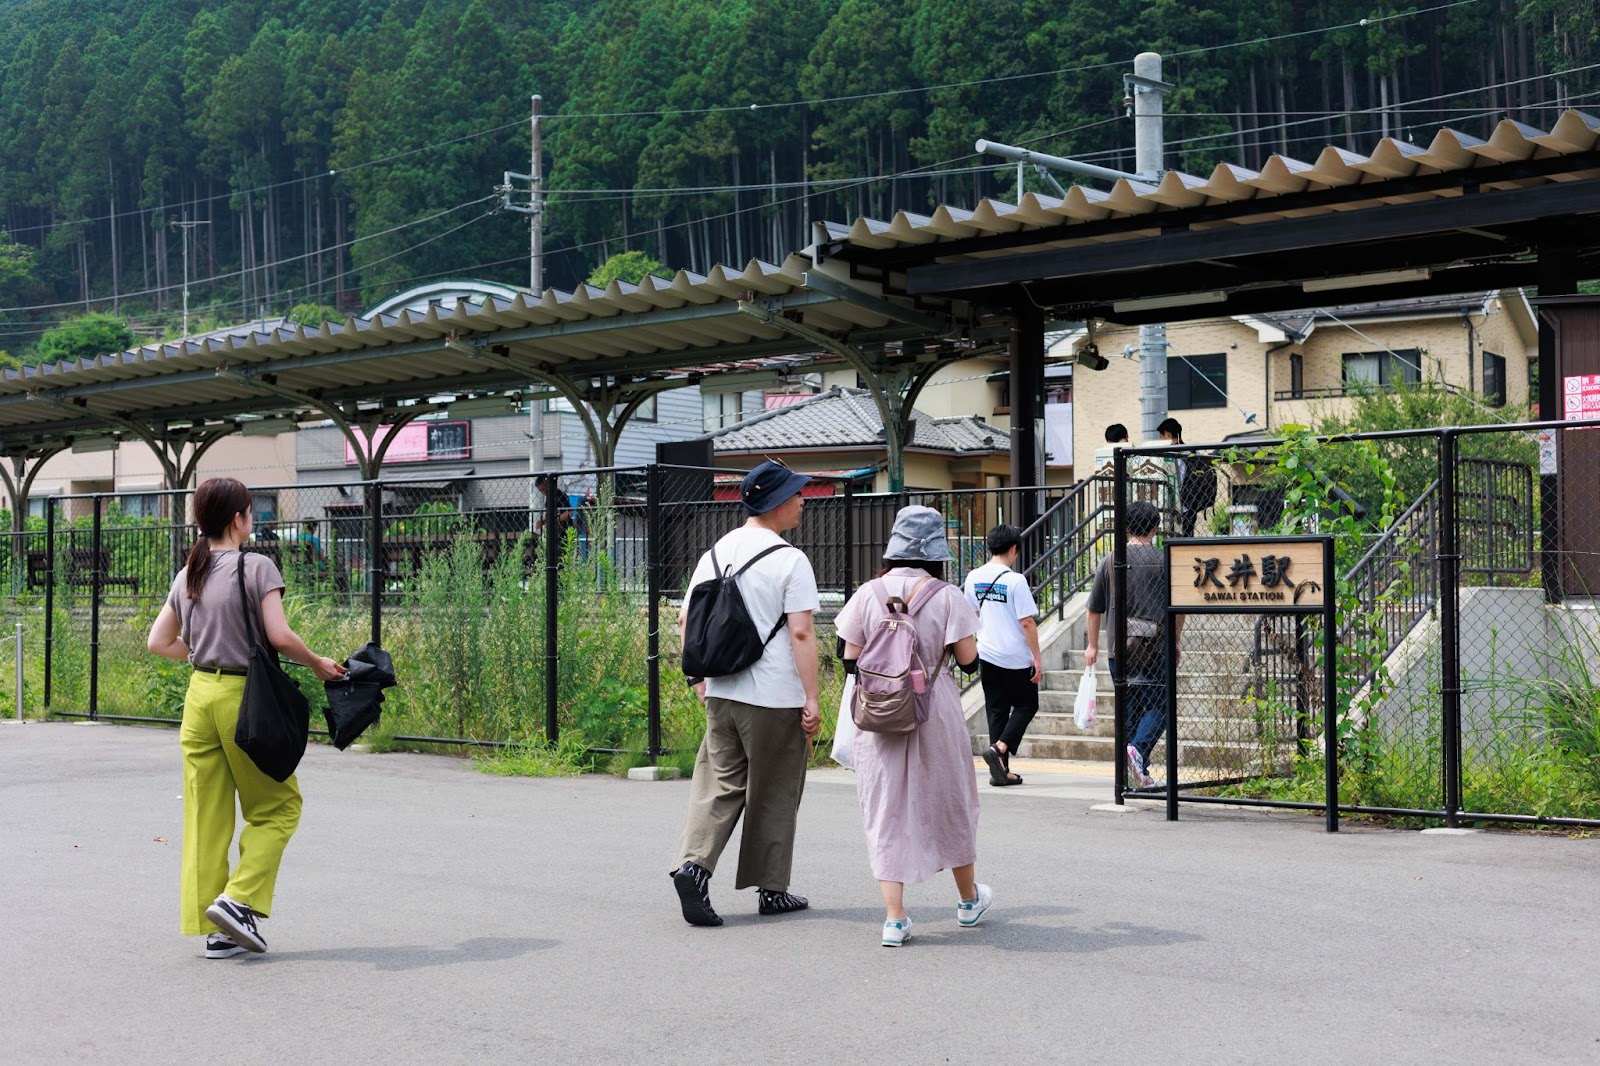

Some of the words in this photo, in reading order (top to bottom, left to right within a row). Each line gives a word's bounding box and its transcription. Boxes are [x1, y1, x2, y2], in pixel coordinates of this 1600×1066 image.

[1193, 553, 1295, 589] 沢井駅
[1204, 592, 1236, 601] SAWAI
[1240, 592, 1284, 601] STATION
